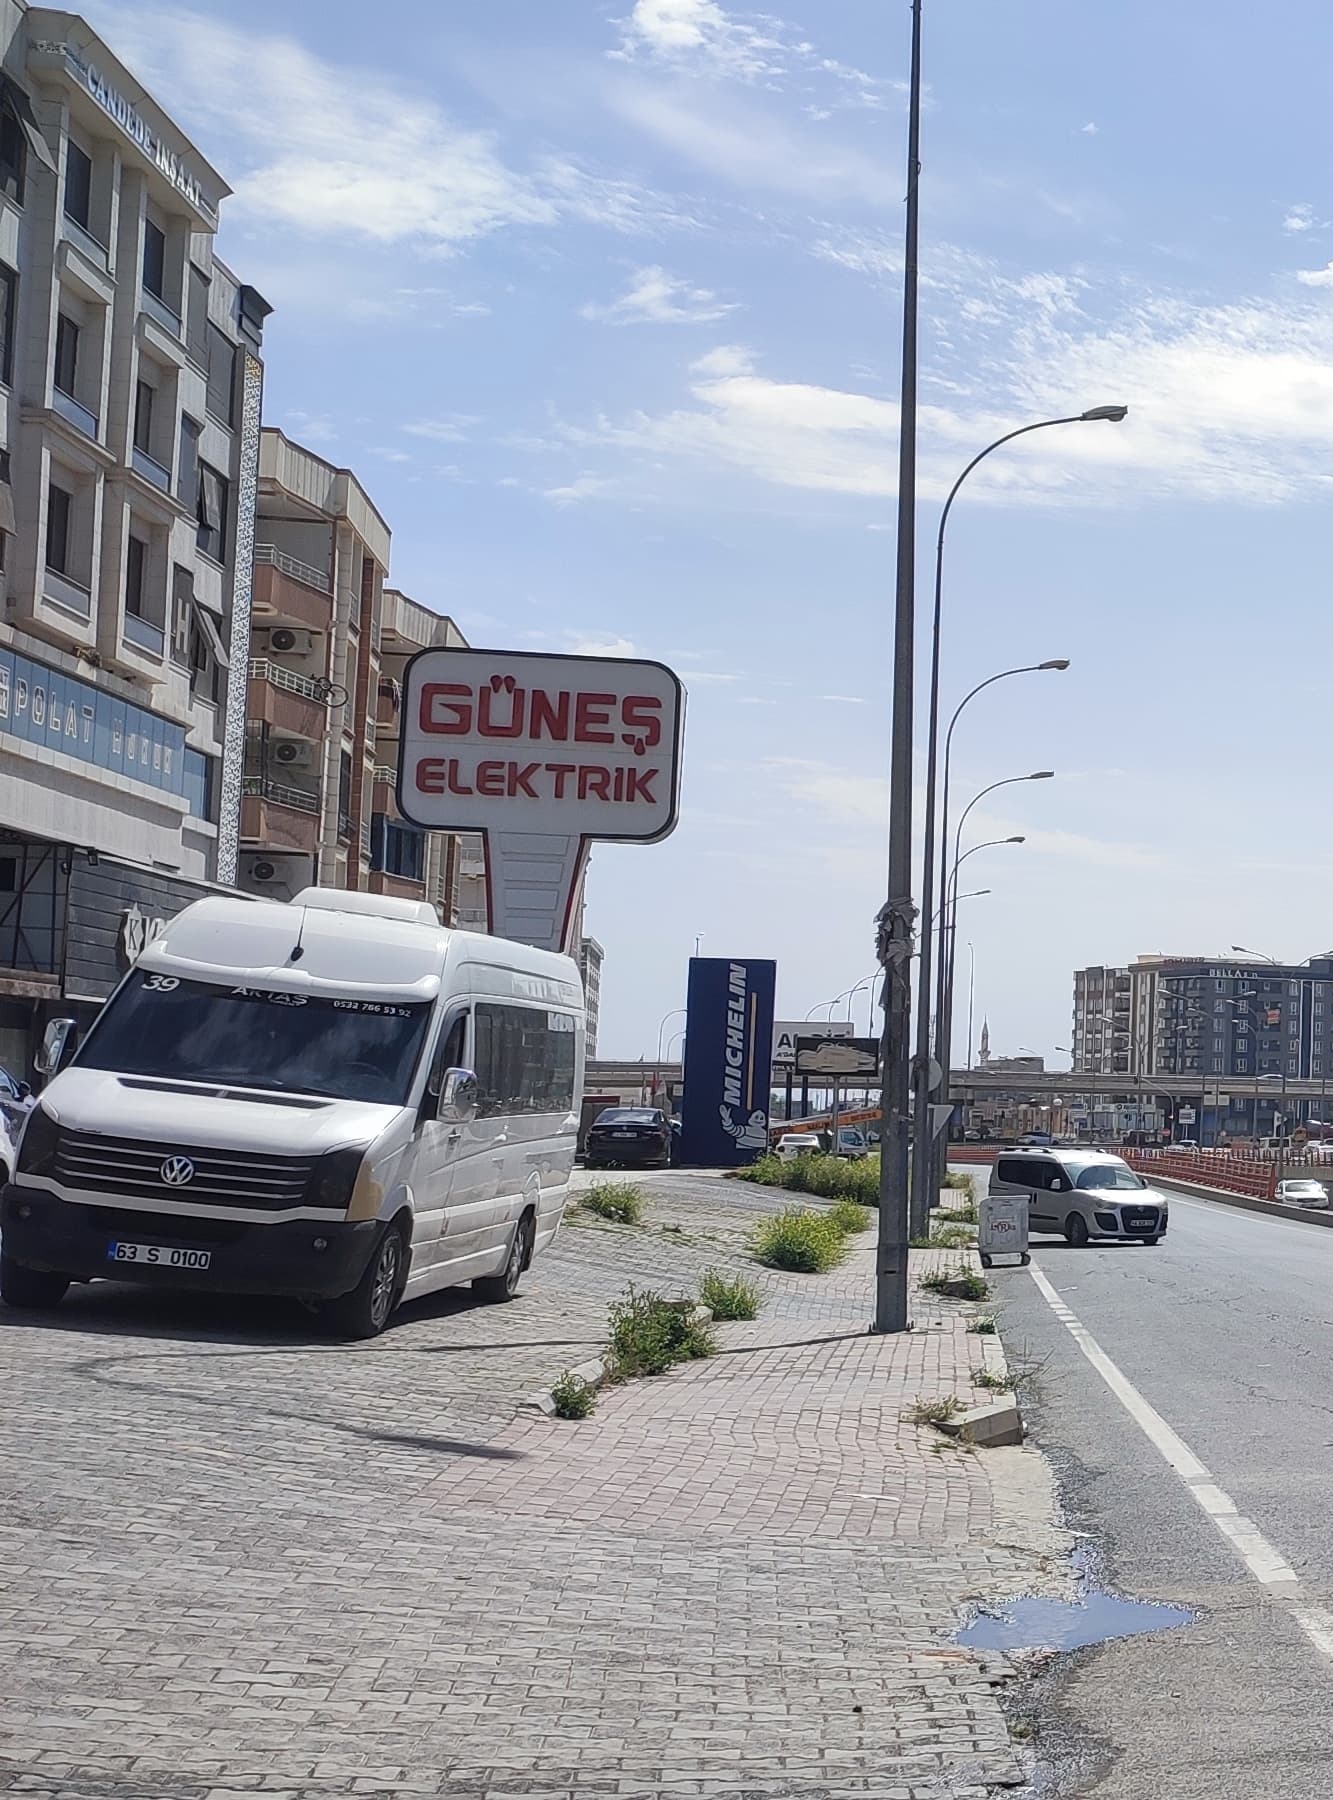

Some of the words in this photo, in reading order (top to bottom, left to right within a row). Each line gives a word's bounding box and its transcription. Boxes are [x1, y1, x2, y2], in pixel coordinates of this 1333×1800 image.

[15, 677, 94, 744] POLAT
[419, 674, 663, 756] GÜNEŞ
[141, 975, 180, 992] 39
[723, 962, 748, 1107] MICHELIN
[116, 1244, 138, 1260] 63
[147, 1247, 160, 1263] S
[170, 1250, 209, 1268] 0100
